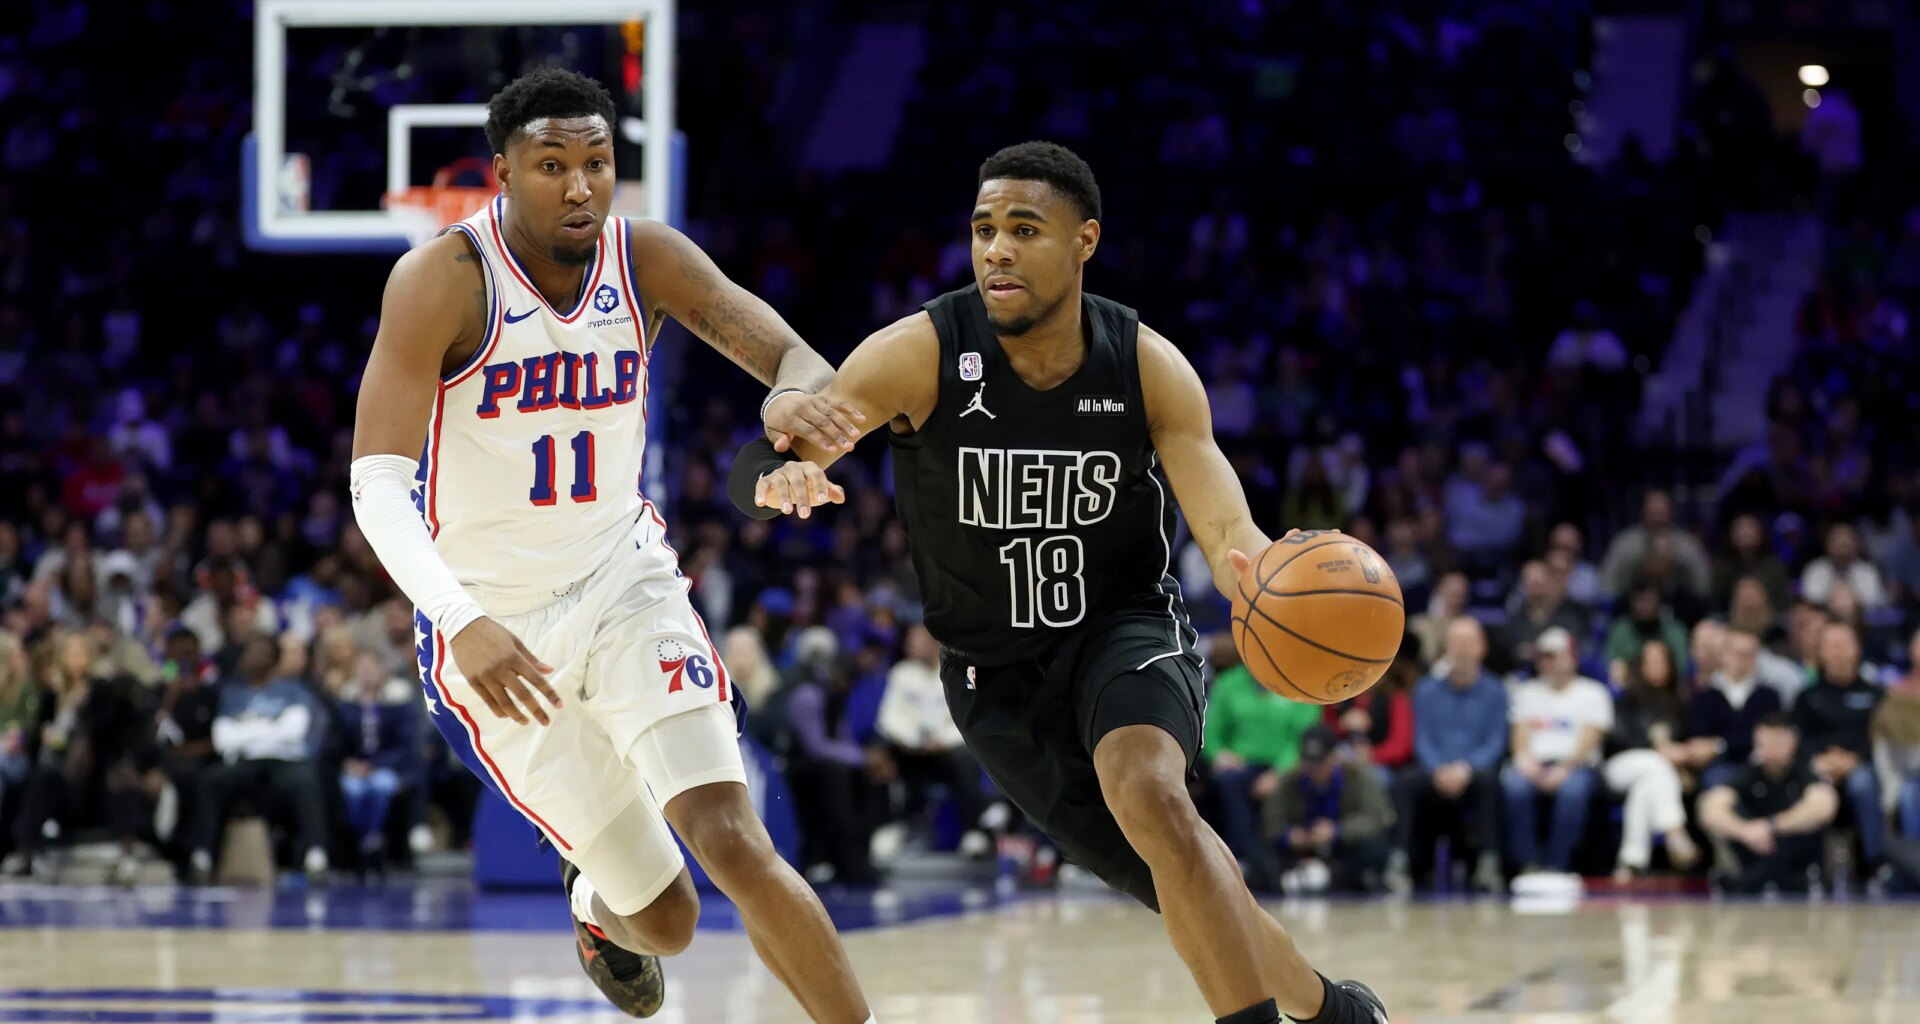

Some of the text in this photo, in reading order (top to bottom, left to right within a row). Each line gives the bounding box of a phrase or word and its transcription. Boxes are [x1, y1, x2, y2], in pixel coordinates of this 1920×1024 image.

[476, 350, 641, 419] PHILA
[1078, 399, 1124, 412] All In Won
[529, 431, 597, 506] 11
[958, 446, 1121, 530] NETS
[999, 535, 1086, 628] 18
[658, 655, 713, 694] 76
